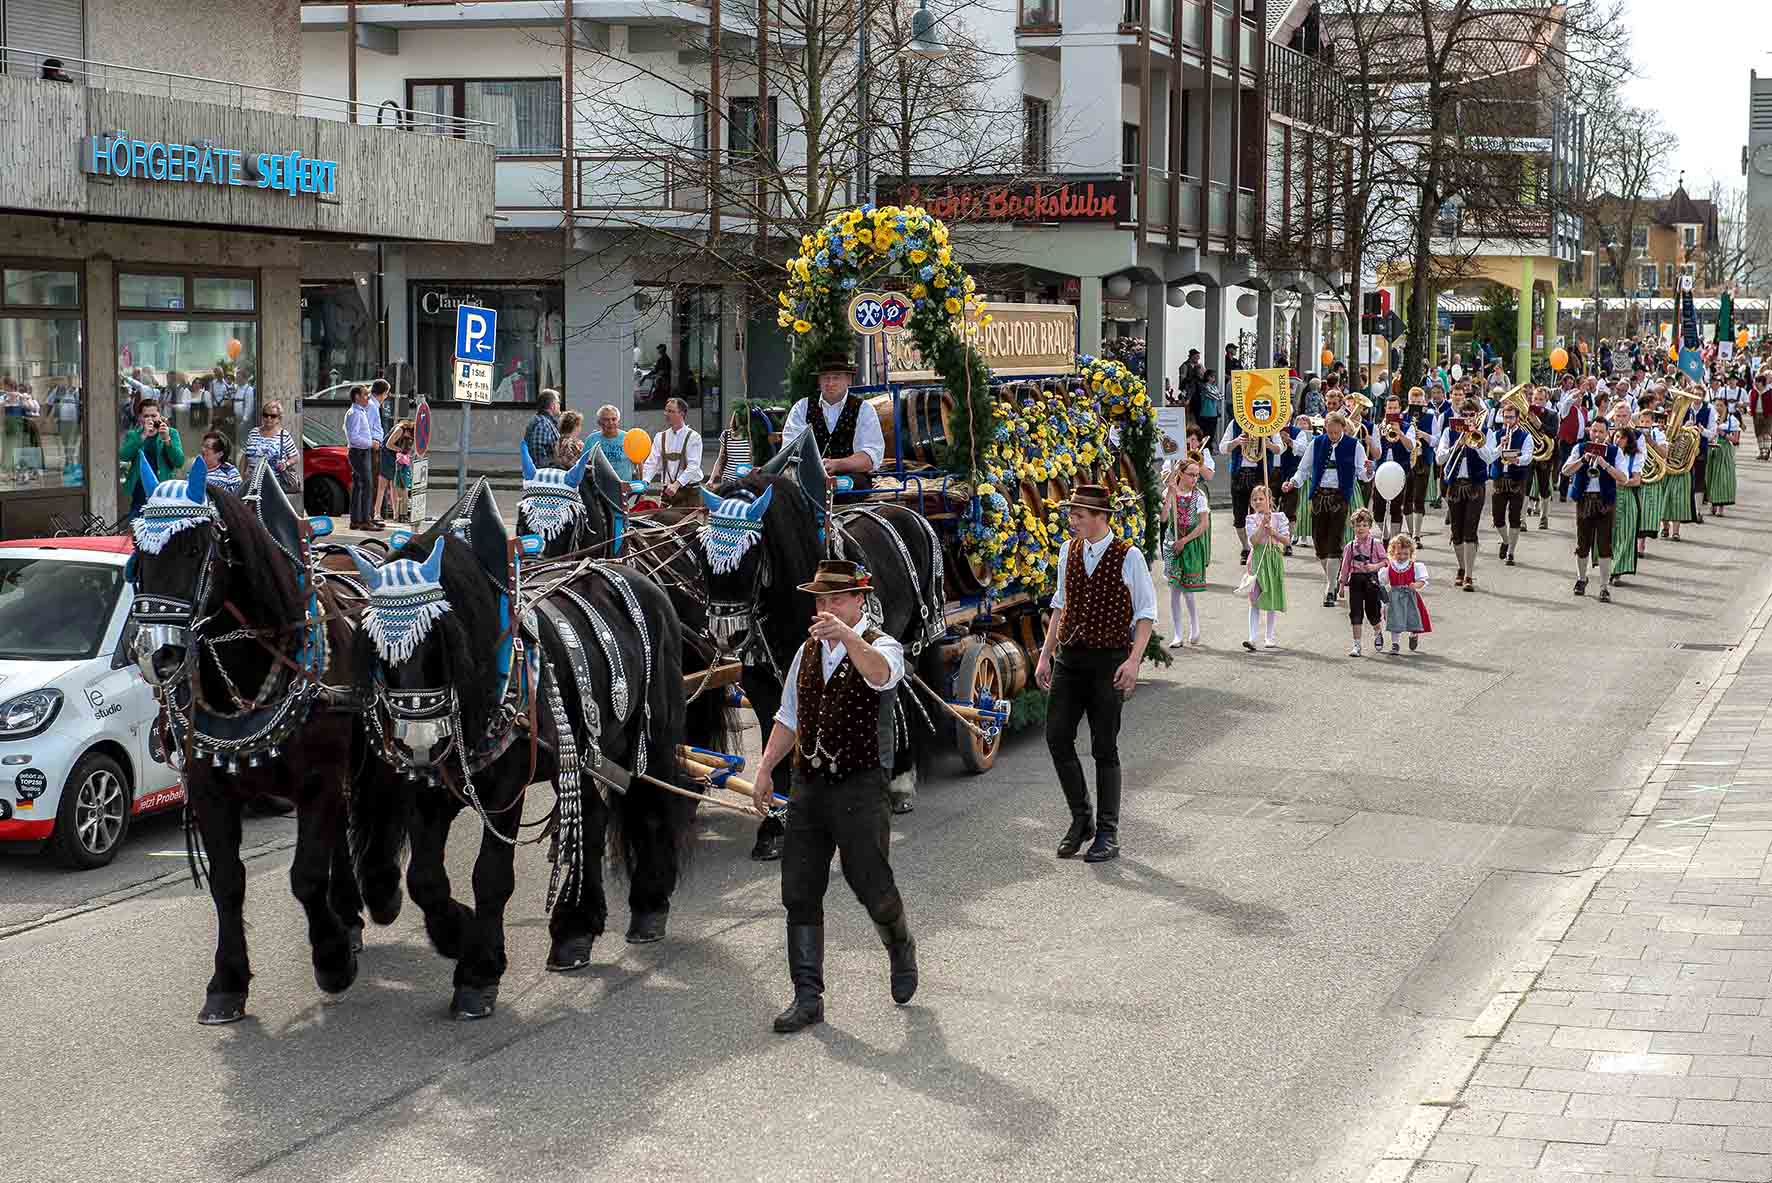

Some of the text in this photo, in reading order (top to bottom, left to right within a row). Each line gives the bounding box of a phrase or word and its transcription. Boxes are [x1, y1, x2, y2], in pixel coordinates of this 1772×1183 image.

[92, 129, 242, 186] HÖRGERÄTE
[422, 291, 483, 314] Claudia
[465, 313, 487, 353] P
[1040, 320, 1069, 355] BRÄU
[1234, 374, 1288, 433] PUCHHEIMER BLASORCHESTER
[94, 703, 122, 720] studio
